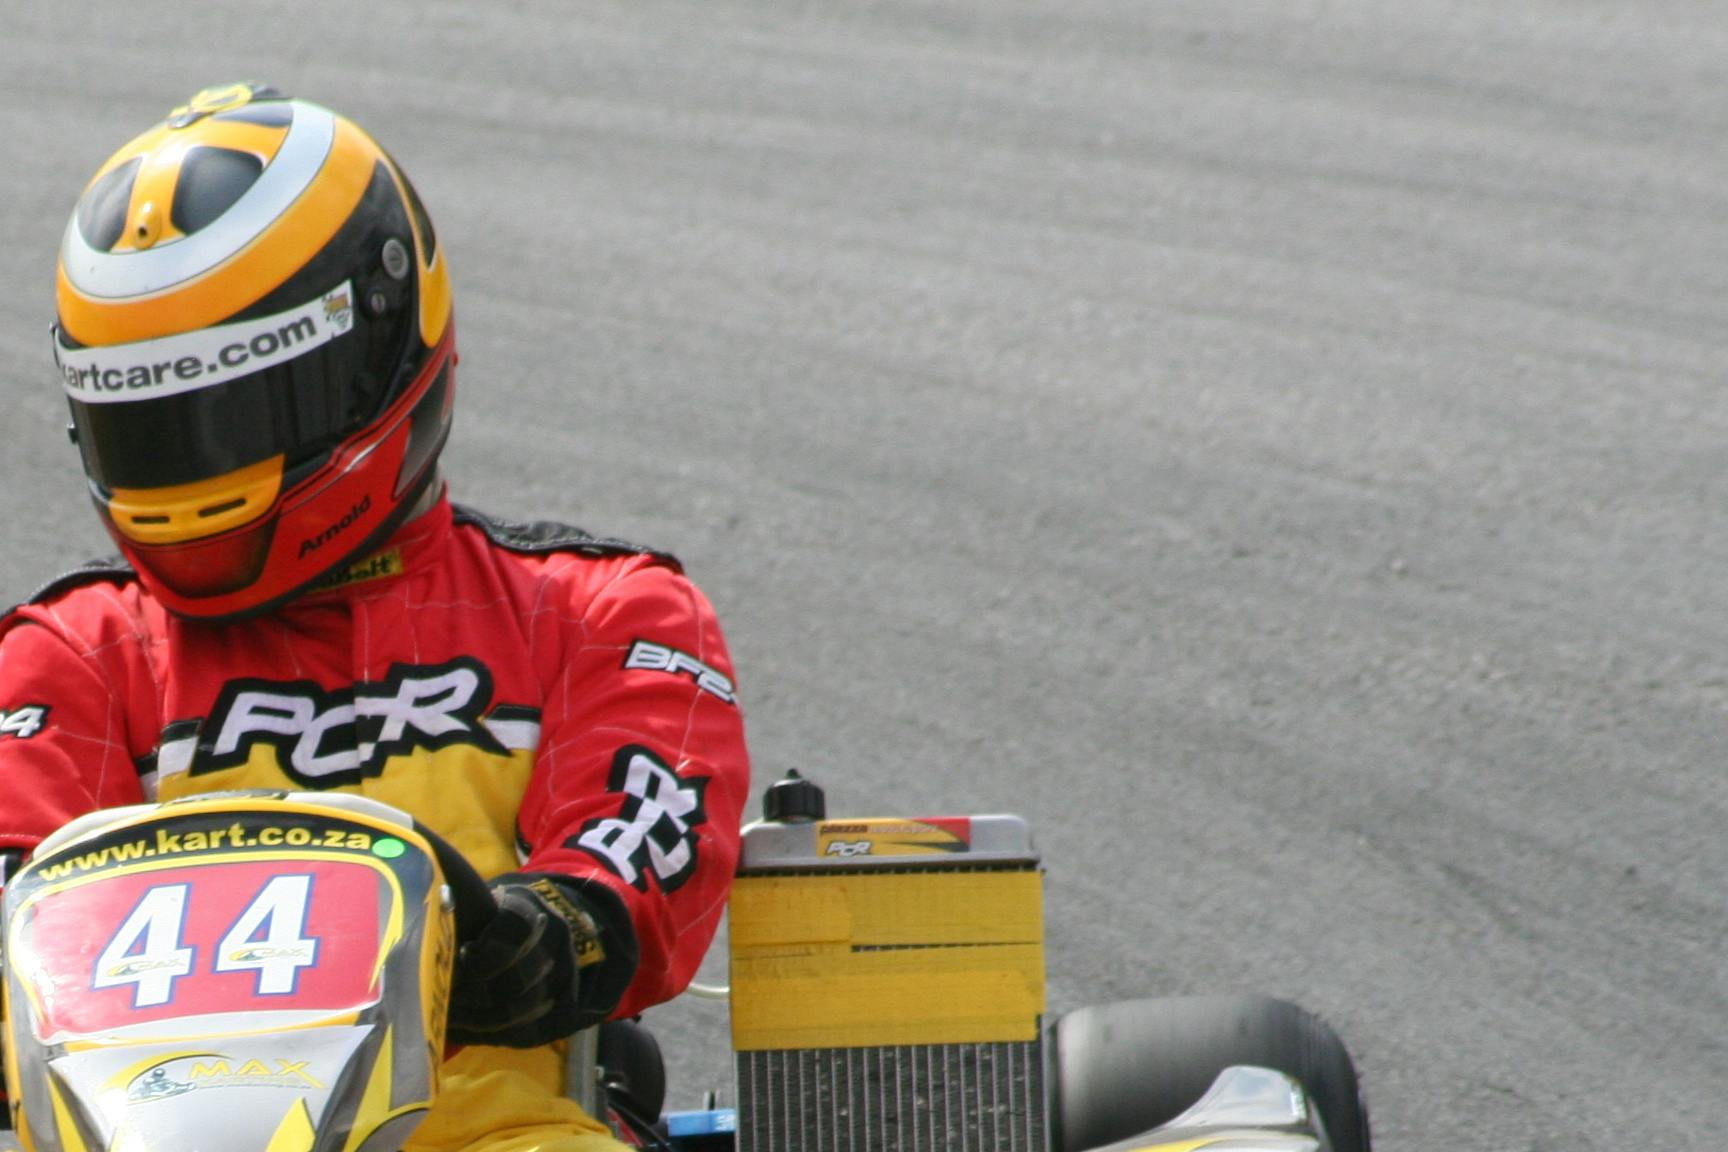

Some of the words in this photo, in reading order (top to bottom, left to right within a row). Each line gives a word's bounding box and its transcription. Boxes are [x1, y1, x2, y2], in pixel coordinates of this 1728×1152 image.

[62, 315, 317, 392] artcare.com
[298, 495, 372, 559] Arnold
[625, 641, 738, 705] BF2
[214, 666, 480, 779] PCR
[38, 823, 373, 882] www.kart.co.za
[91, 872, 320, 1009] 44
